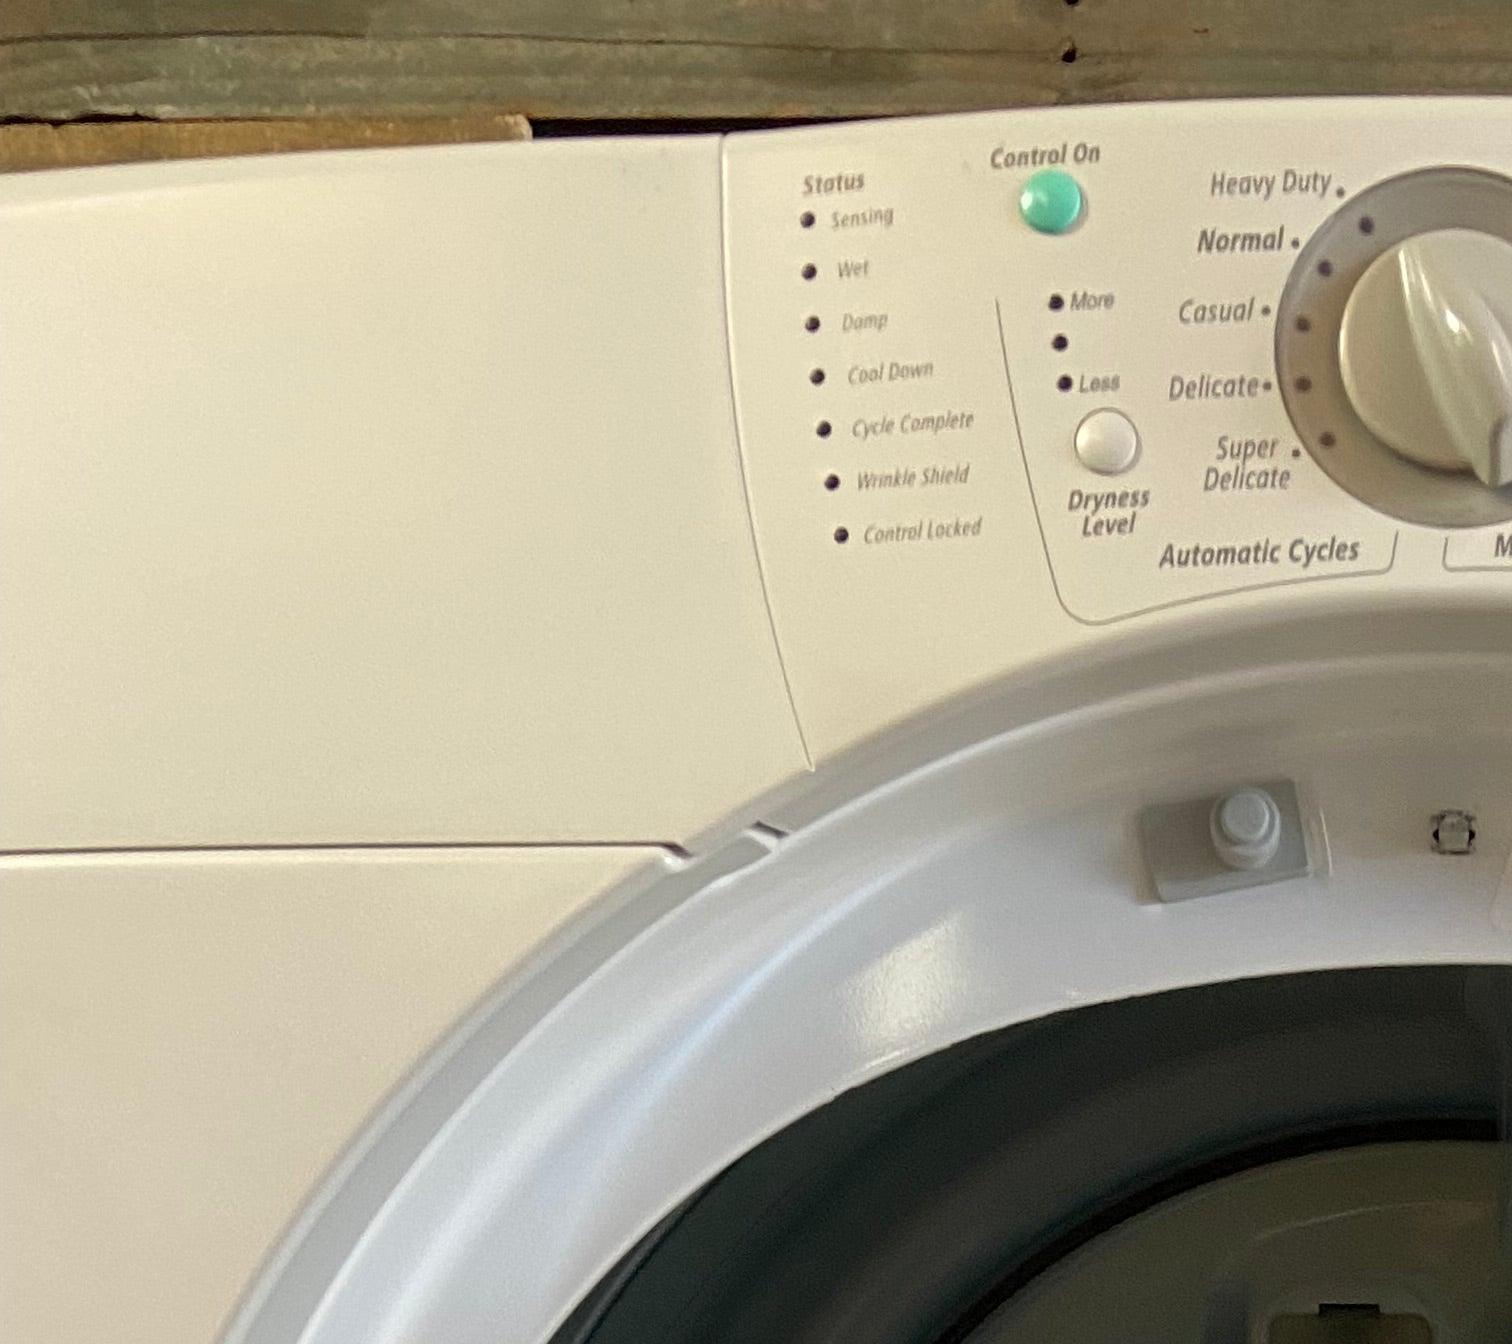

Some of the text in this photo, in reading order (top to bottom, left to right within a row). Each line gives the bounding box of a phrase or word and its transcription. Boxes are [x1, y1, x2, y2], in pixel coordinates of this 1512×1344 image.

[990, 143, 1100, 169] Control On
[803, 172, 864, 194] Status
[1211, 170, 1331, 200] Heavy Duty
[831, 207, 894, 229] Sensing
[1198, 225, 1284, 253] Normal
[837, 261, 868, 278] Wet
[1070, 292, 1114, 311] More
[1179, 297, 1254, 325] Casual
[842, 312, 888, 332] Damp
[848, 361, 933, 384] Cool Down
[1080, 374, 1120, 393] Less
[1169, 375, 1258, 401] Delicate
[852, 411, 974, 440] Cycle Complete
[1217, 435, 1278, 464] Super
[857, 464, 970, 490] Wrinkle Shield
[1204, 466, 1290, 492] Delicate
[1068, 488, 1149, 515] Dryness
[864, 517, 982, 544] Control Locked
[1082, 514, 1136, 536] Level
[1159, 535, 1359, 569] Automatic Cycles
